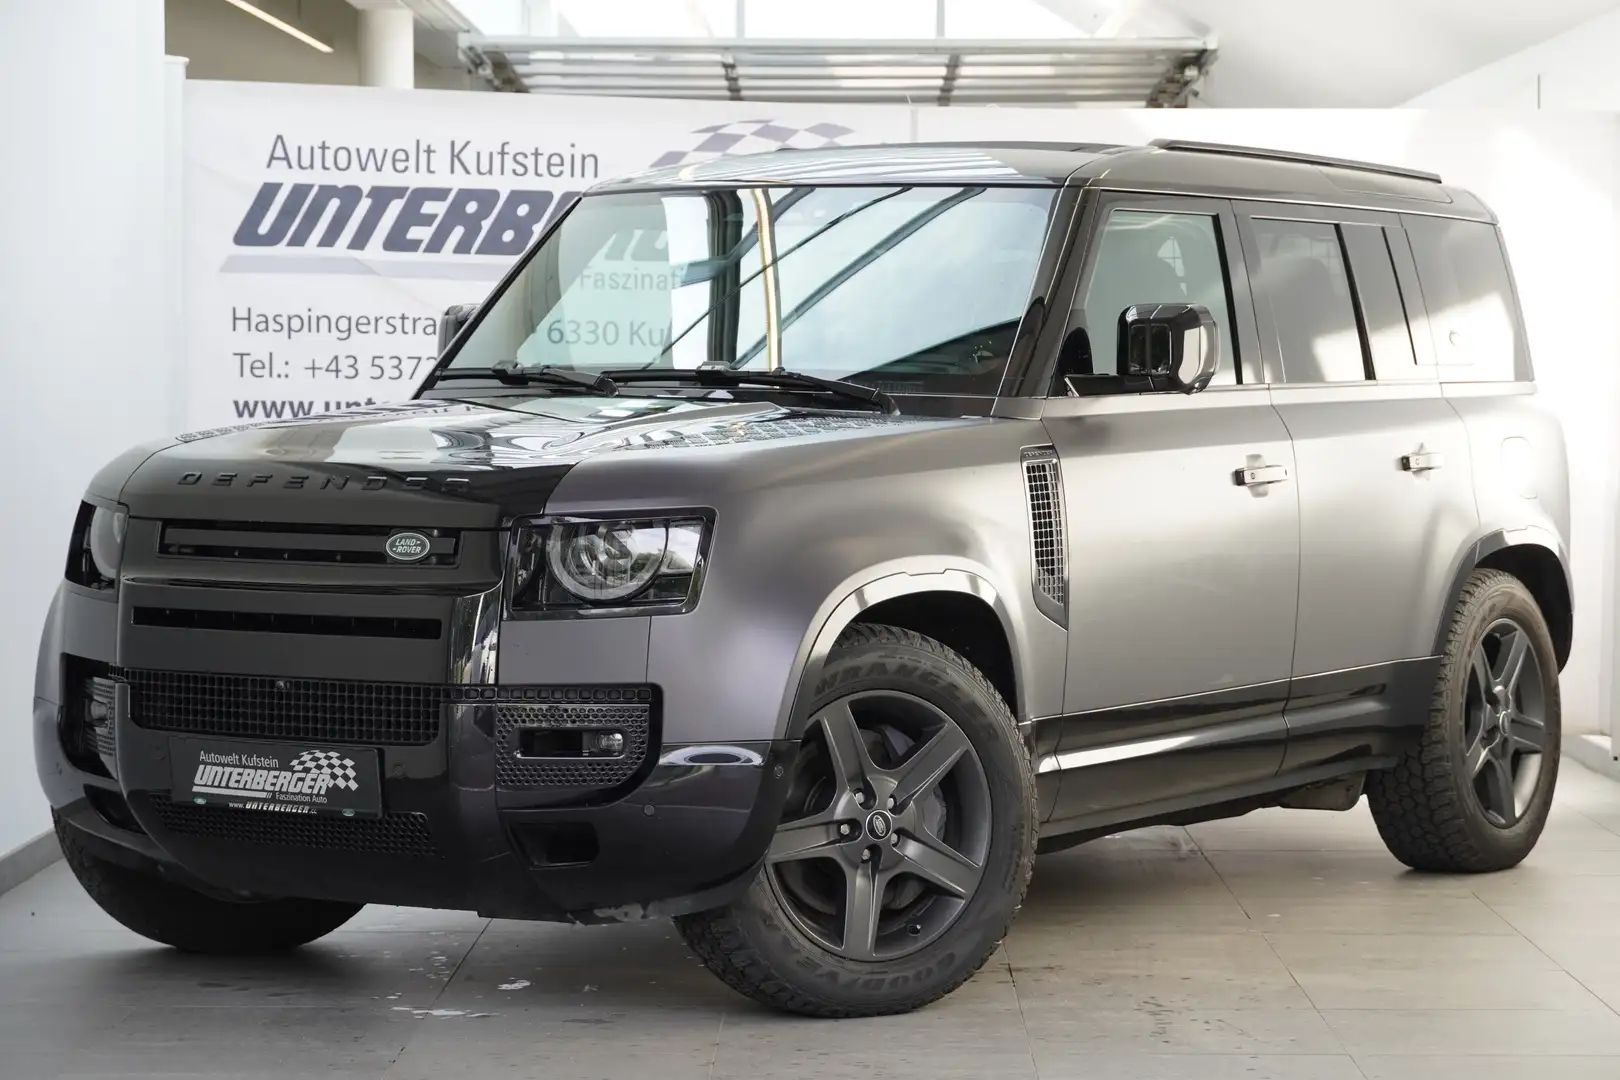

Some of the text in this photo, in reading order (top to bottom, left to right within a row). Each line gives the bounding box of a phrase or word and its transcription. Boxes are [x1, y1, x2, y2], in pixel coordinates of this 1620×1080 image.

[266, 134, 599, 179] Autowelt Kufstein
[547, 319, 620, 347] 6330
[233, 351, 290, 379] Tel.:
[304, 354, 360, 380] +43
[177, 472, 471, 493] DEFENDER
[200, 750, 279, 768] Autowelt Kufstein
[194, 764, 332, 795] UNTERBERGER
[275, 791, 328, 804] Faszination Auto
